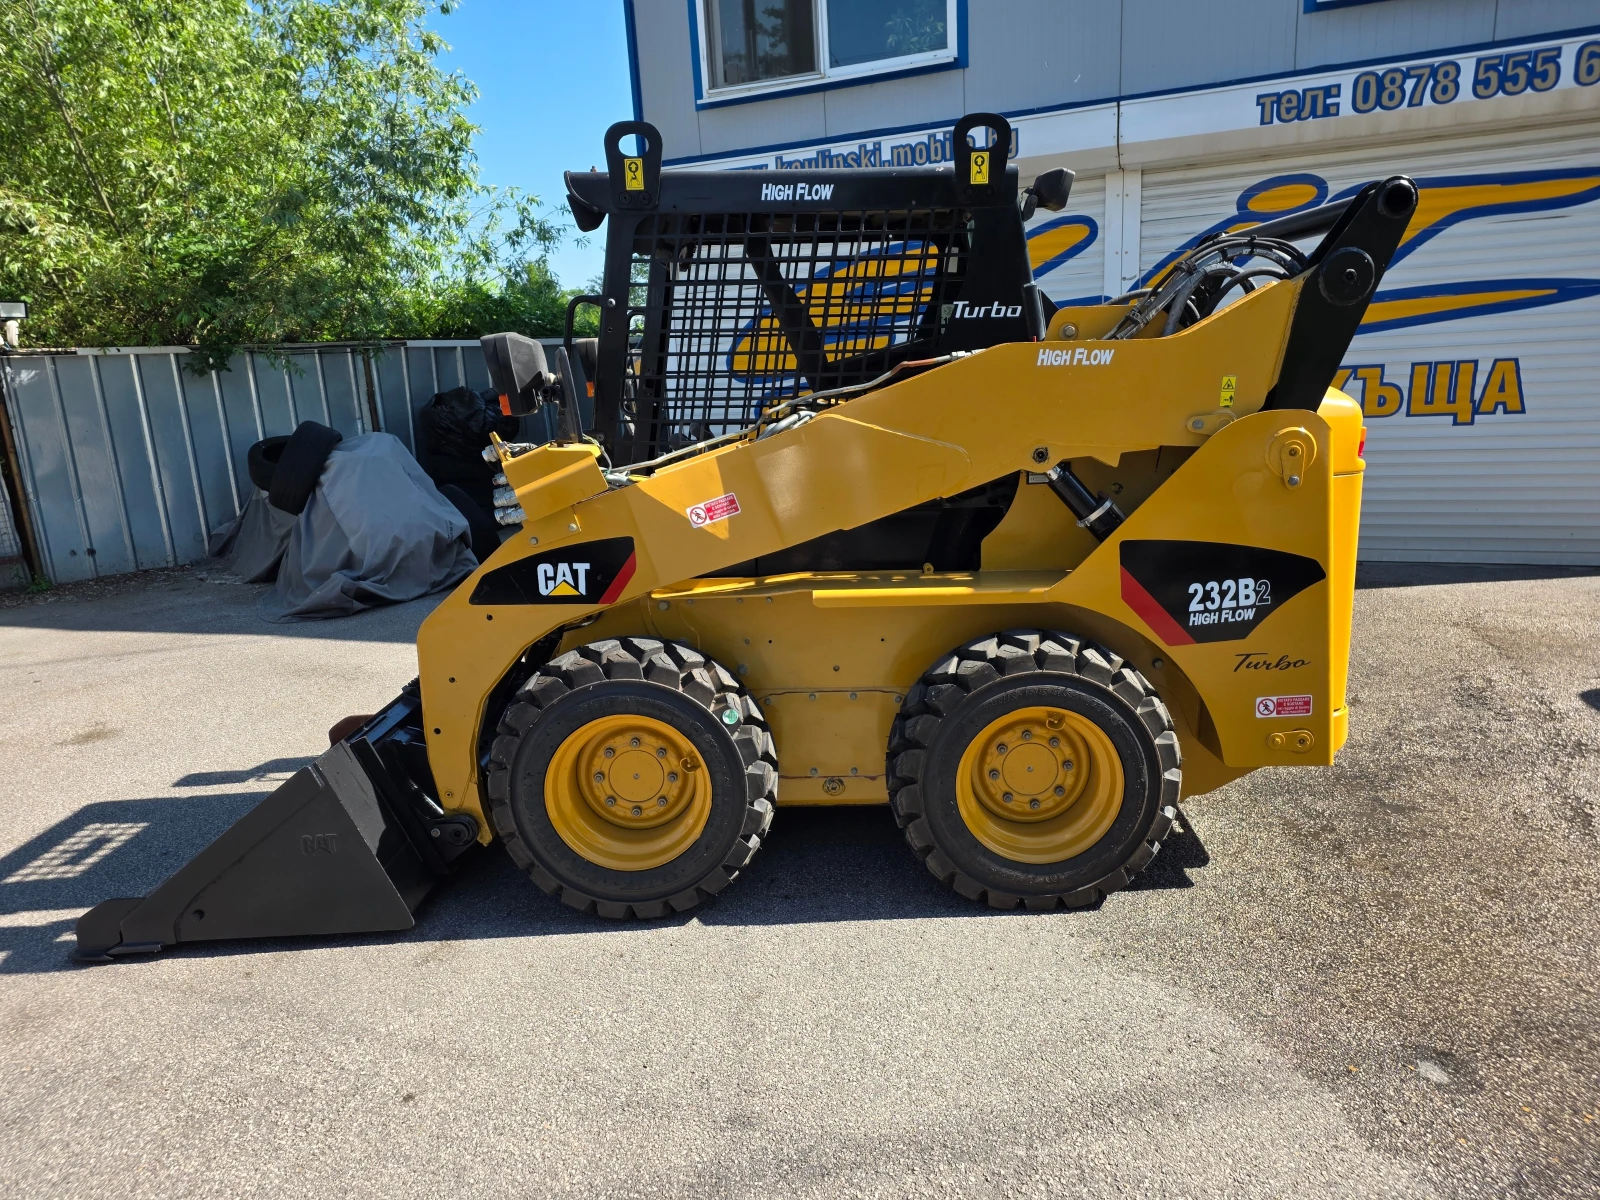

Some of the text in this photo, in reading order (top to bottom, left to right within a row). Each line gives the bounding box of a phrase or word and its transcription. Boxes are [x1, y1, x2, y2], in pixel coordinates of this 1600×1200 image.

[1256, 83, 1341, 126] тел:
[1351, 61, 1461, 113] 0878
[1472, 46, 1562, 99] 555
[953, 300, 1022, 318] Turbo
[537, 562, 590, 596] CAT
[1233, 652, 1311, 672] Turbo
[300, 833, 337, 856] CAT
